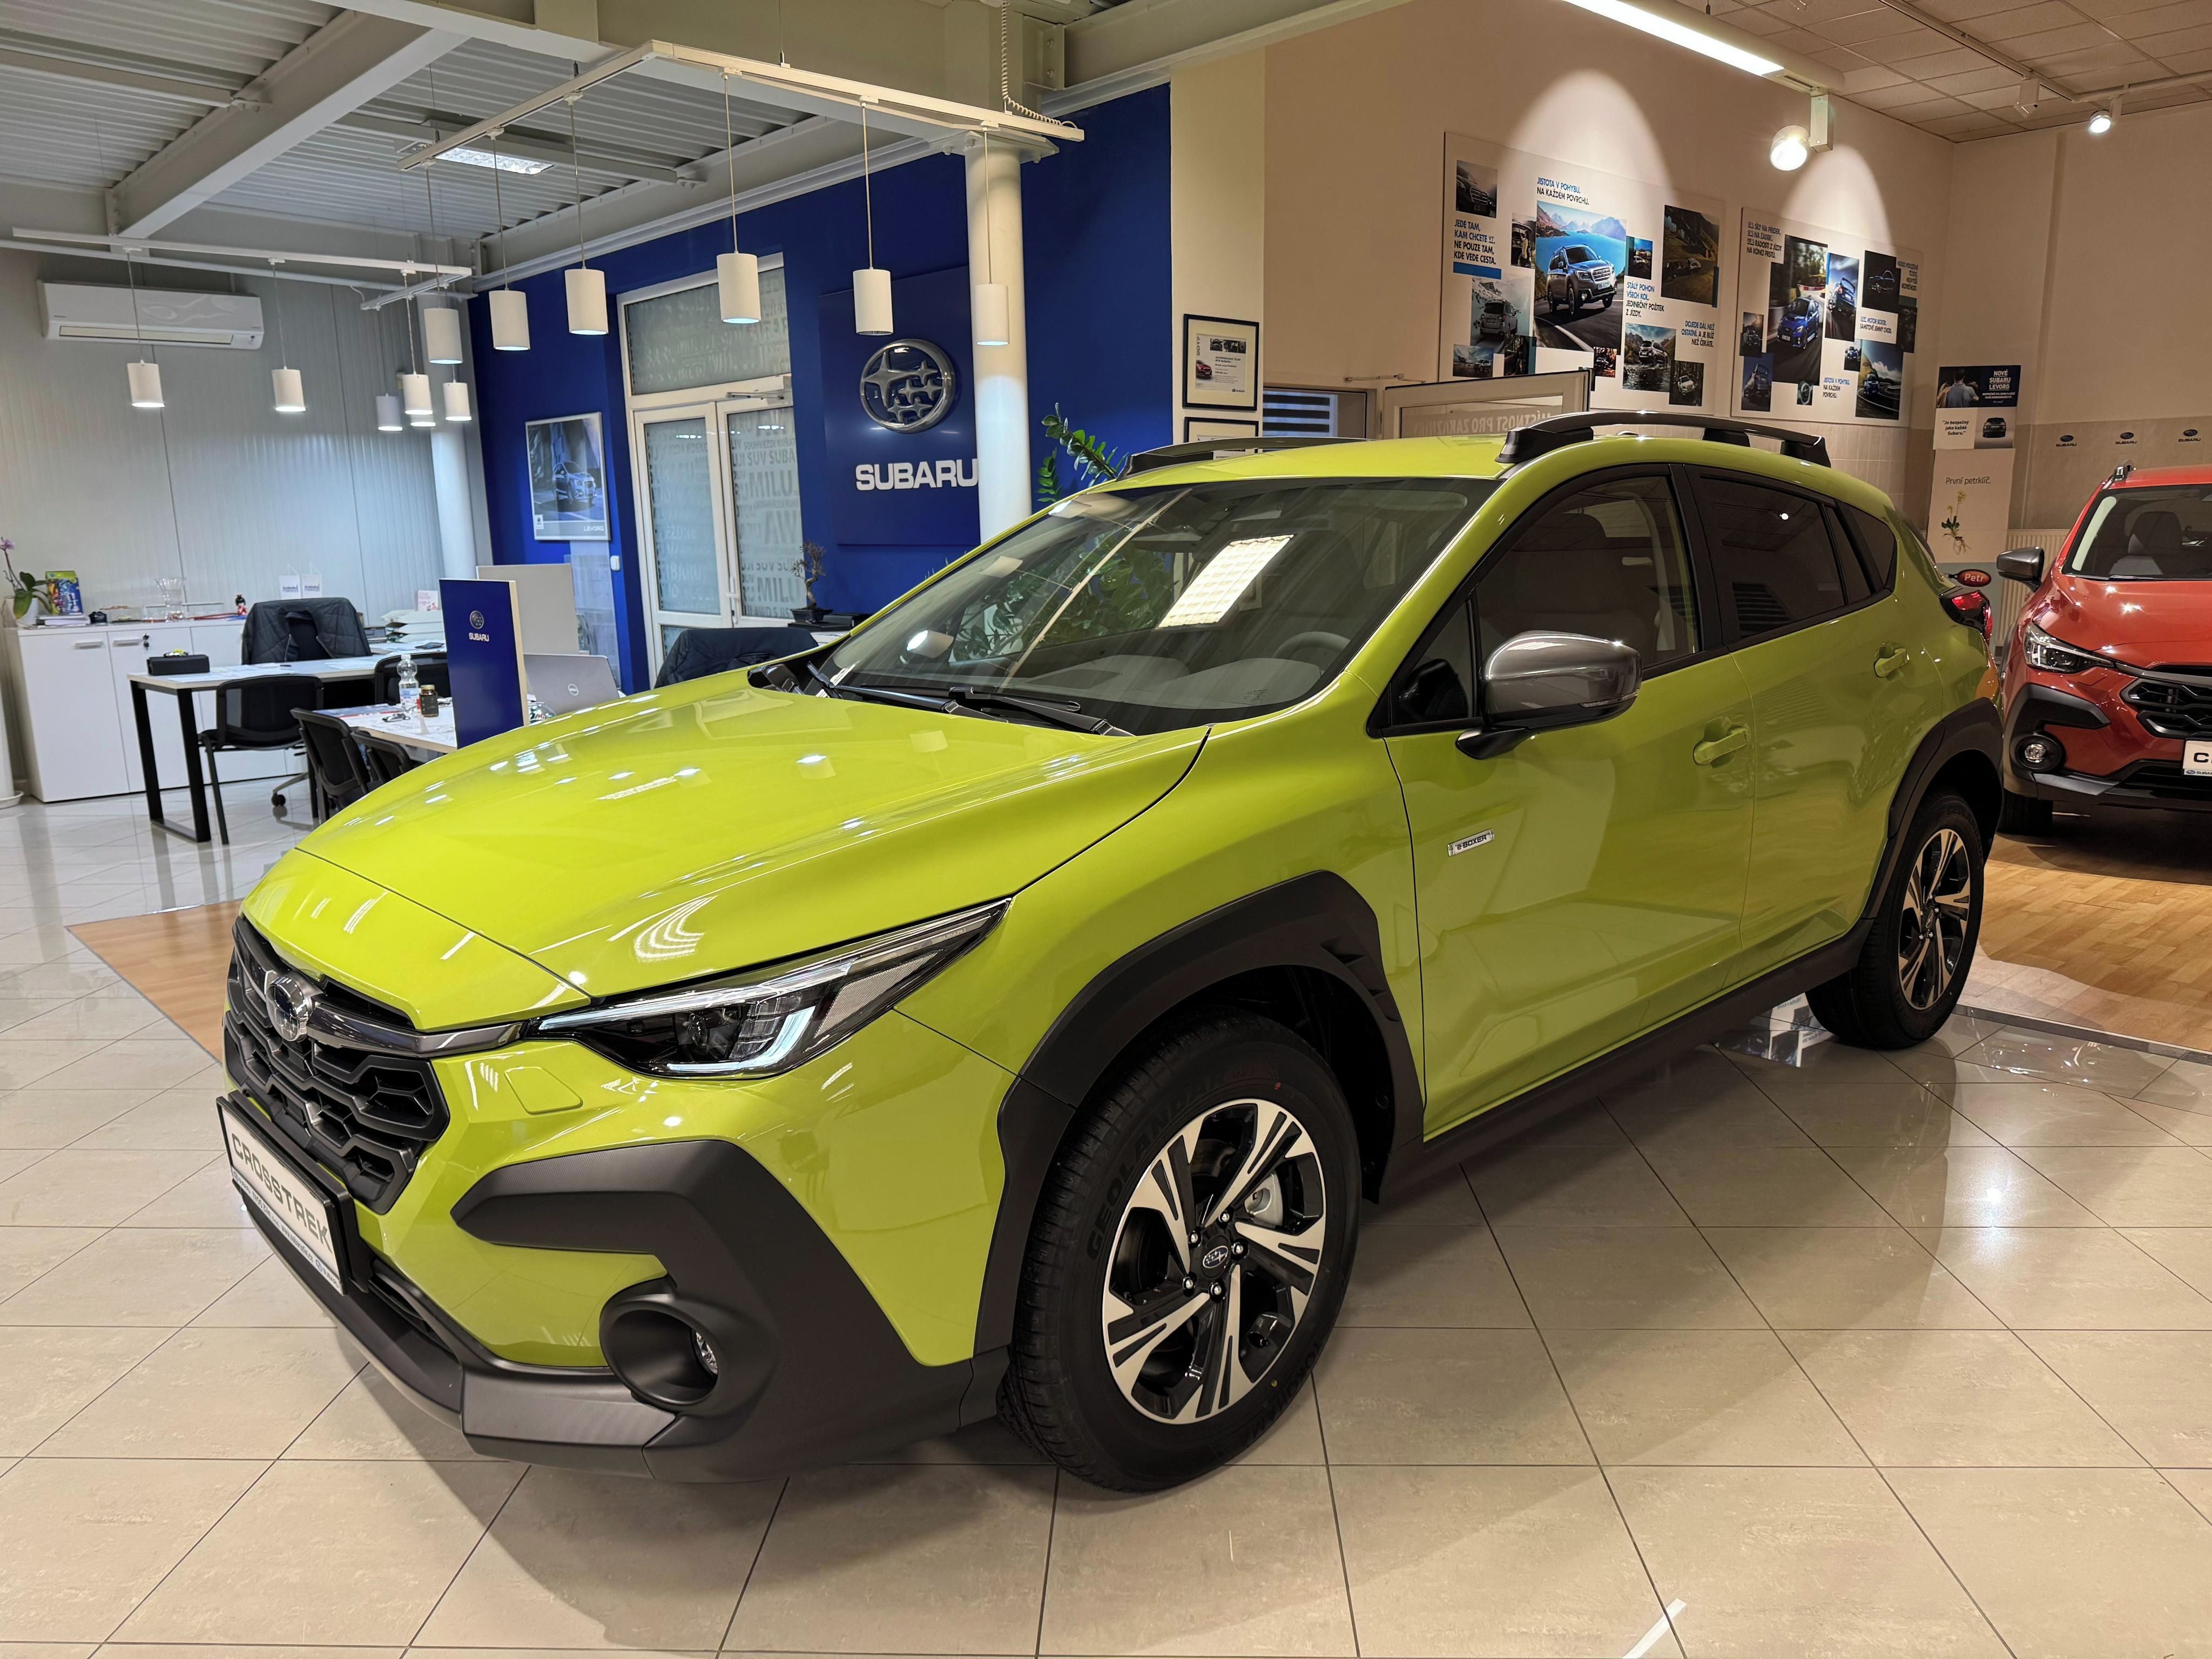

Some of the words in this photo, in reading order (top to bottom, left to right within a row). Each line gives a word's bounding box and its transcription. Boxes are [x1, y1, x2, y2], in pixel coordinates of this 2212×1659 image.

[1537, 177, 1554, 187] JISTOTA
[1561, 183, 1581, 193] POHYBU.
[1537, 187, 1545, 195] NA
[1546, 188, 1565, 199] KAŽDÉM
[1567, 194, 1589, 205] POVRCHU.
[1455, 219, 1466, 228] JEDE
[1468, 221, 1481, 232] TAM,
[1454, 230, 1467, 239] KAM
[1469, 232, 1487, 242] CHCETE
[1454, 240, 1461, 248] NE
[1463, 241, 1480, 252] POUZE
[1482, 245, 1494, 255] TAM,
[1454, 251, 1464, 259] KDE
[1466, 252, 1479, 262] VEDE
[1480, 255, 1496, 265] CESTA.
[1627, 281, 1638, 290] STÁLÝ
[1640, 284, 1655, 292] POHON
[1627, 290, 1640, 299] VŠECH
[1626, 300, 1648, 309] JEDINEČNÝ
[1649, 302, 1664, 312] POŽITEK
[1993, 368, 2008, 376] NOVÉ
[855, 458, 978, 491] SUBARU
[1964, 476, 1991, 485] petrklíč.
[1965, 574, 1985, 582] Petr
[469, 632, 489, 642] SUBARU
[1457, 834, 1487, 850] e-BOXER
[231, 1132, 333, 1254] CROSSTREK
